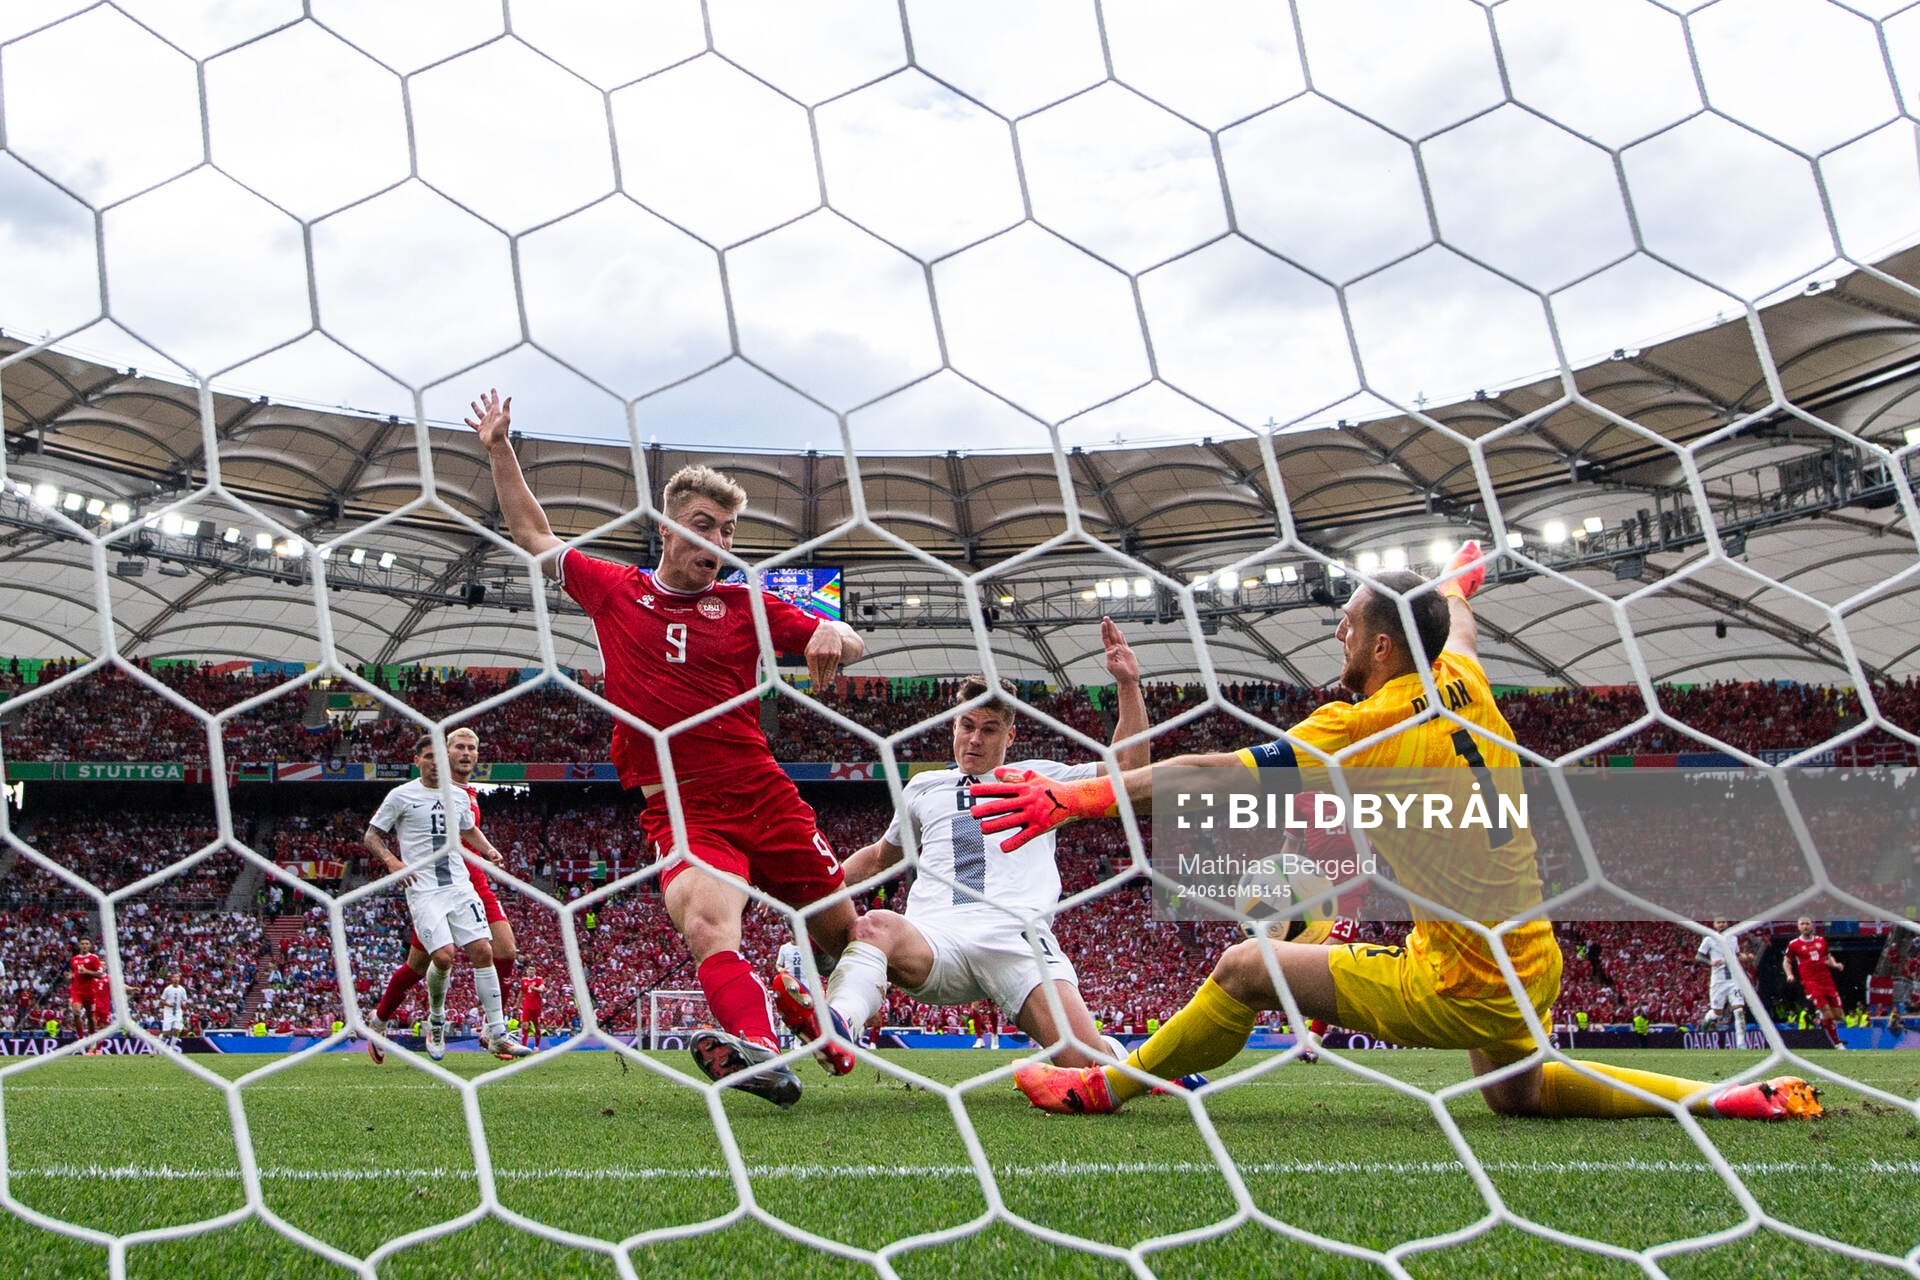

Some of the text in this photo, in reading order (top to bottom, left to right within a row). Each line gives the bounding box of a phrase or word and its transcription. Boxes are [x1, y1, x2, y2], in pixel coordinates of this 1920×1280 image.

[666, 623, 687, 663] 9
[79, 765, 180, 778] STUTTGA
[956, 790, 976, 811] 6
[431, 814, 447, 834] 13
[812, 832, 839, 875] 9
[1332, 915, 1354, 938] 23
[792, 956, 801, 965] 22
[1683, 1032, 1720, 1049] QATAR
